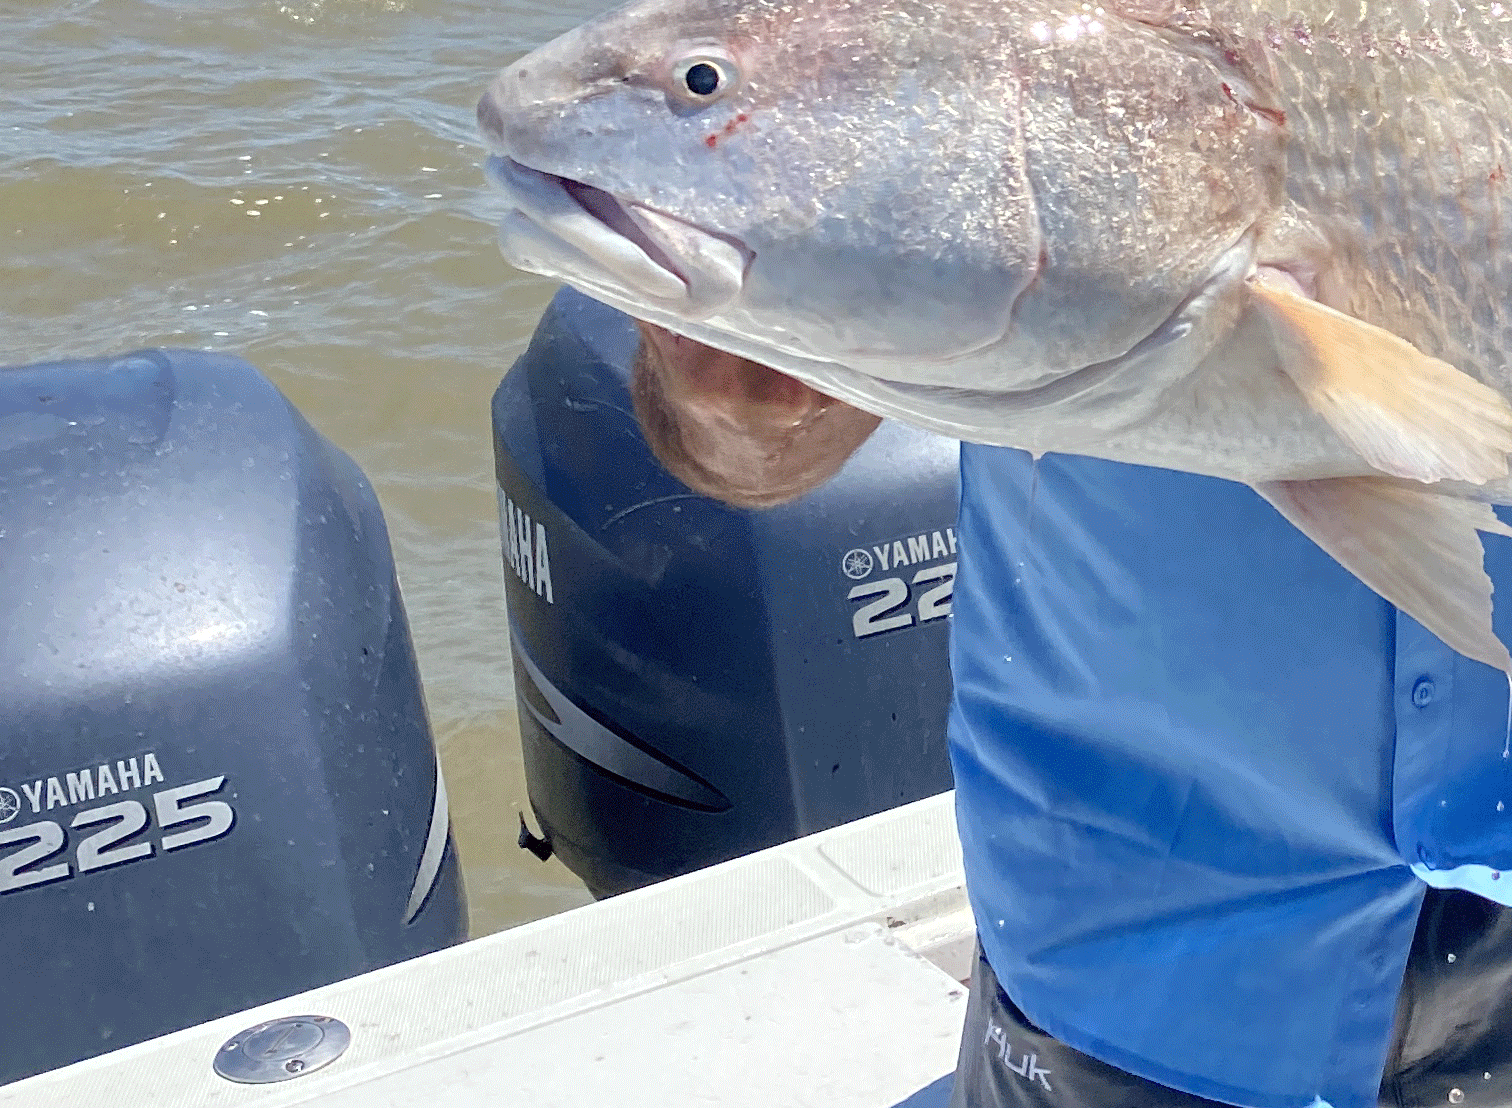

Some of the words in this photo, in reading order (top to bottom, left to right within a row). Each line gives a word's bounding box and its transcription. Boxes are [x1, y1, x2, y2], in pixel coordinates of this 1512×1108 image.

[846, 562, 958, 638] 22
[20, 752, 165, 814] YAMAHA
[0, 774, 236, 895] 225
[983, 1015, 1052, 1092] HUK
